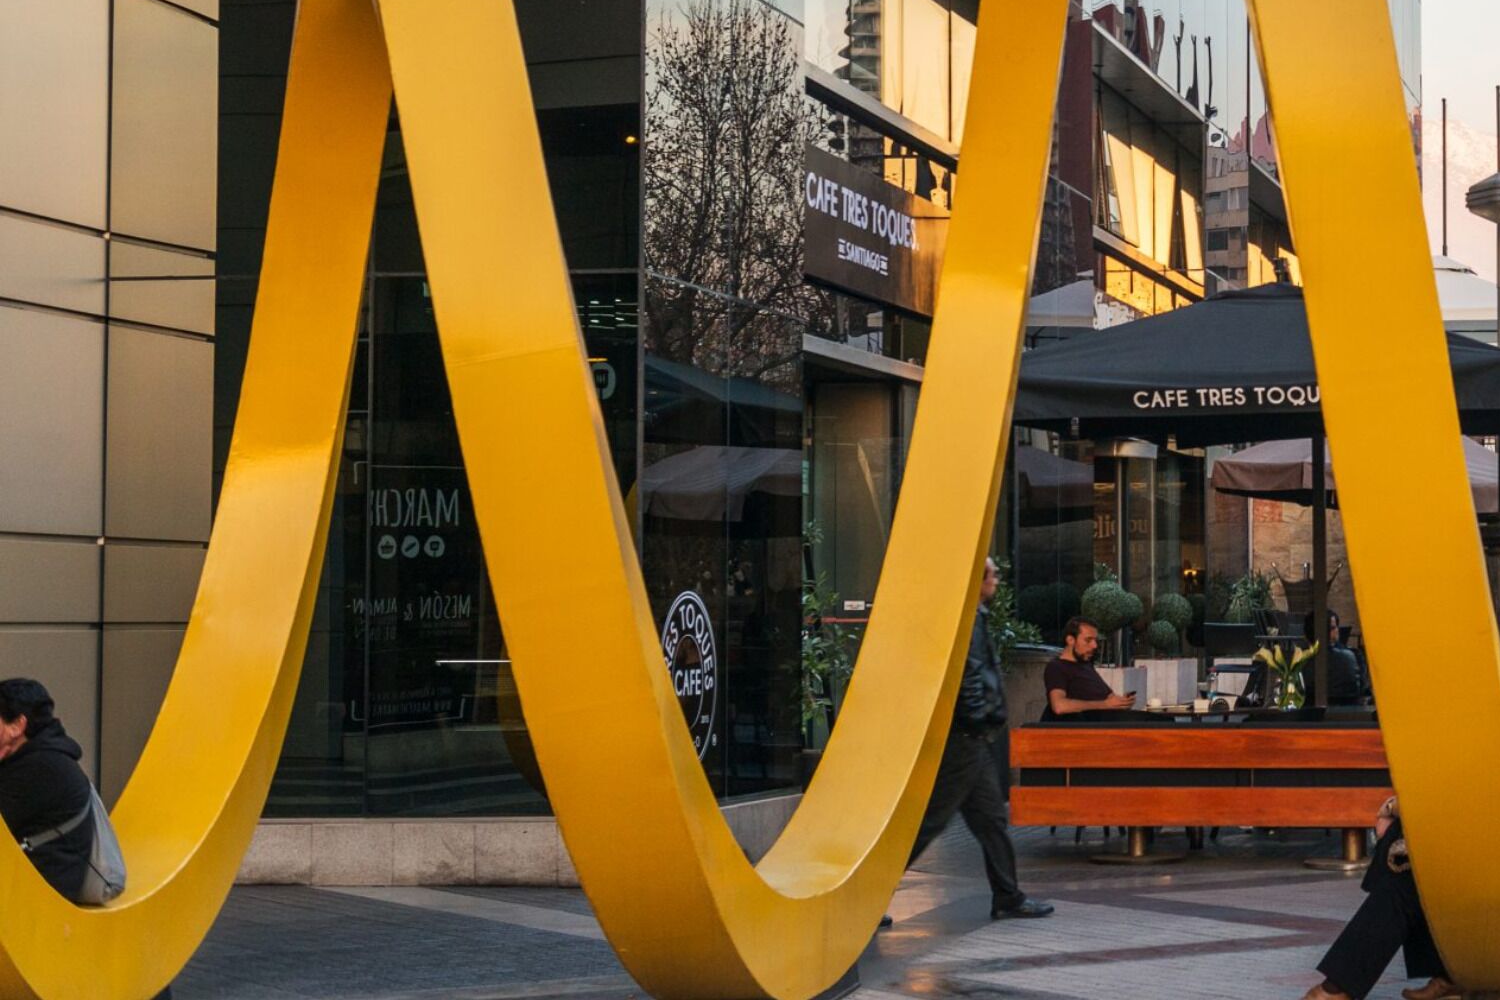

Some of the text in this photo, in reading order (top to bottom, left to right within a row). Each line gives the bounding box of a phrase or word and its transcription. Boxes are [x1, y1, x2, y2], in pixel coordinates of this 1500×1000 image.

[806, 172, 838, 217] CAFE
[841, 186, 868, 230] TRES
[846, 242, 881, 271] SANTIAGO
[1133, 385, 1320, 409] CAFE TRES TOQU
[679, 603, 714, 690] TOQUES
[674, 669, 701, 696] CAFE
